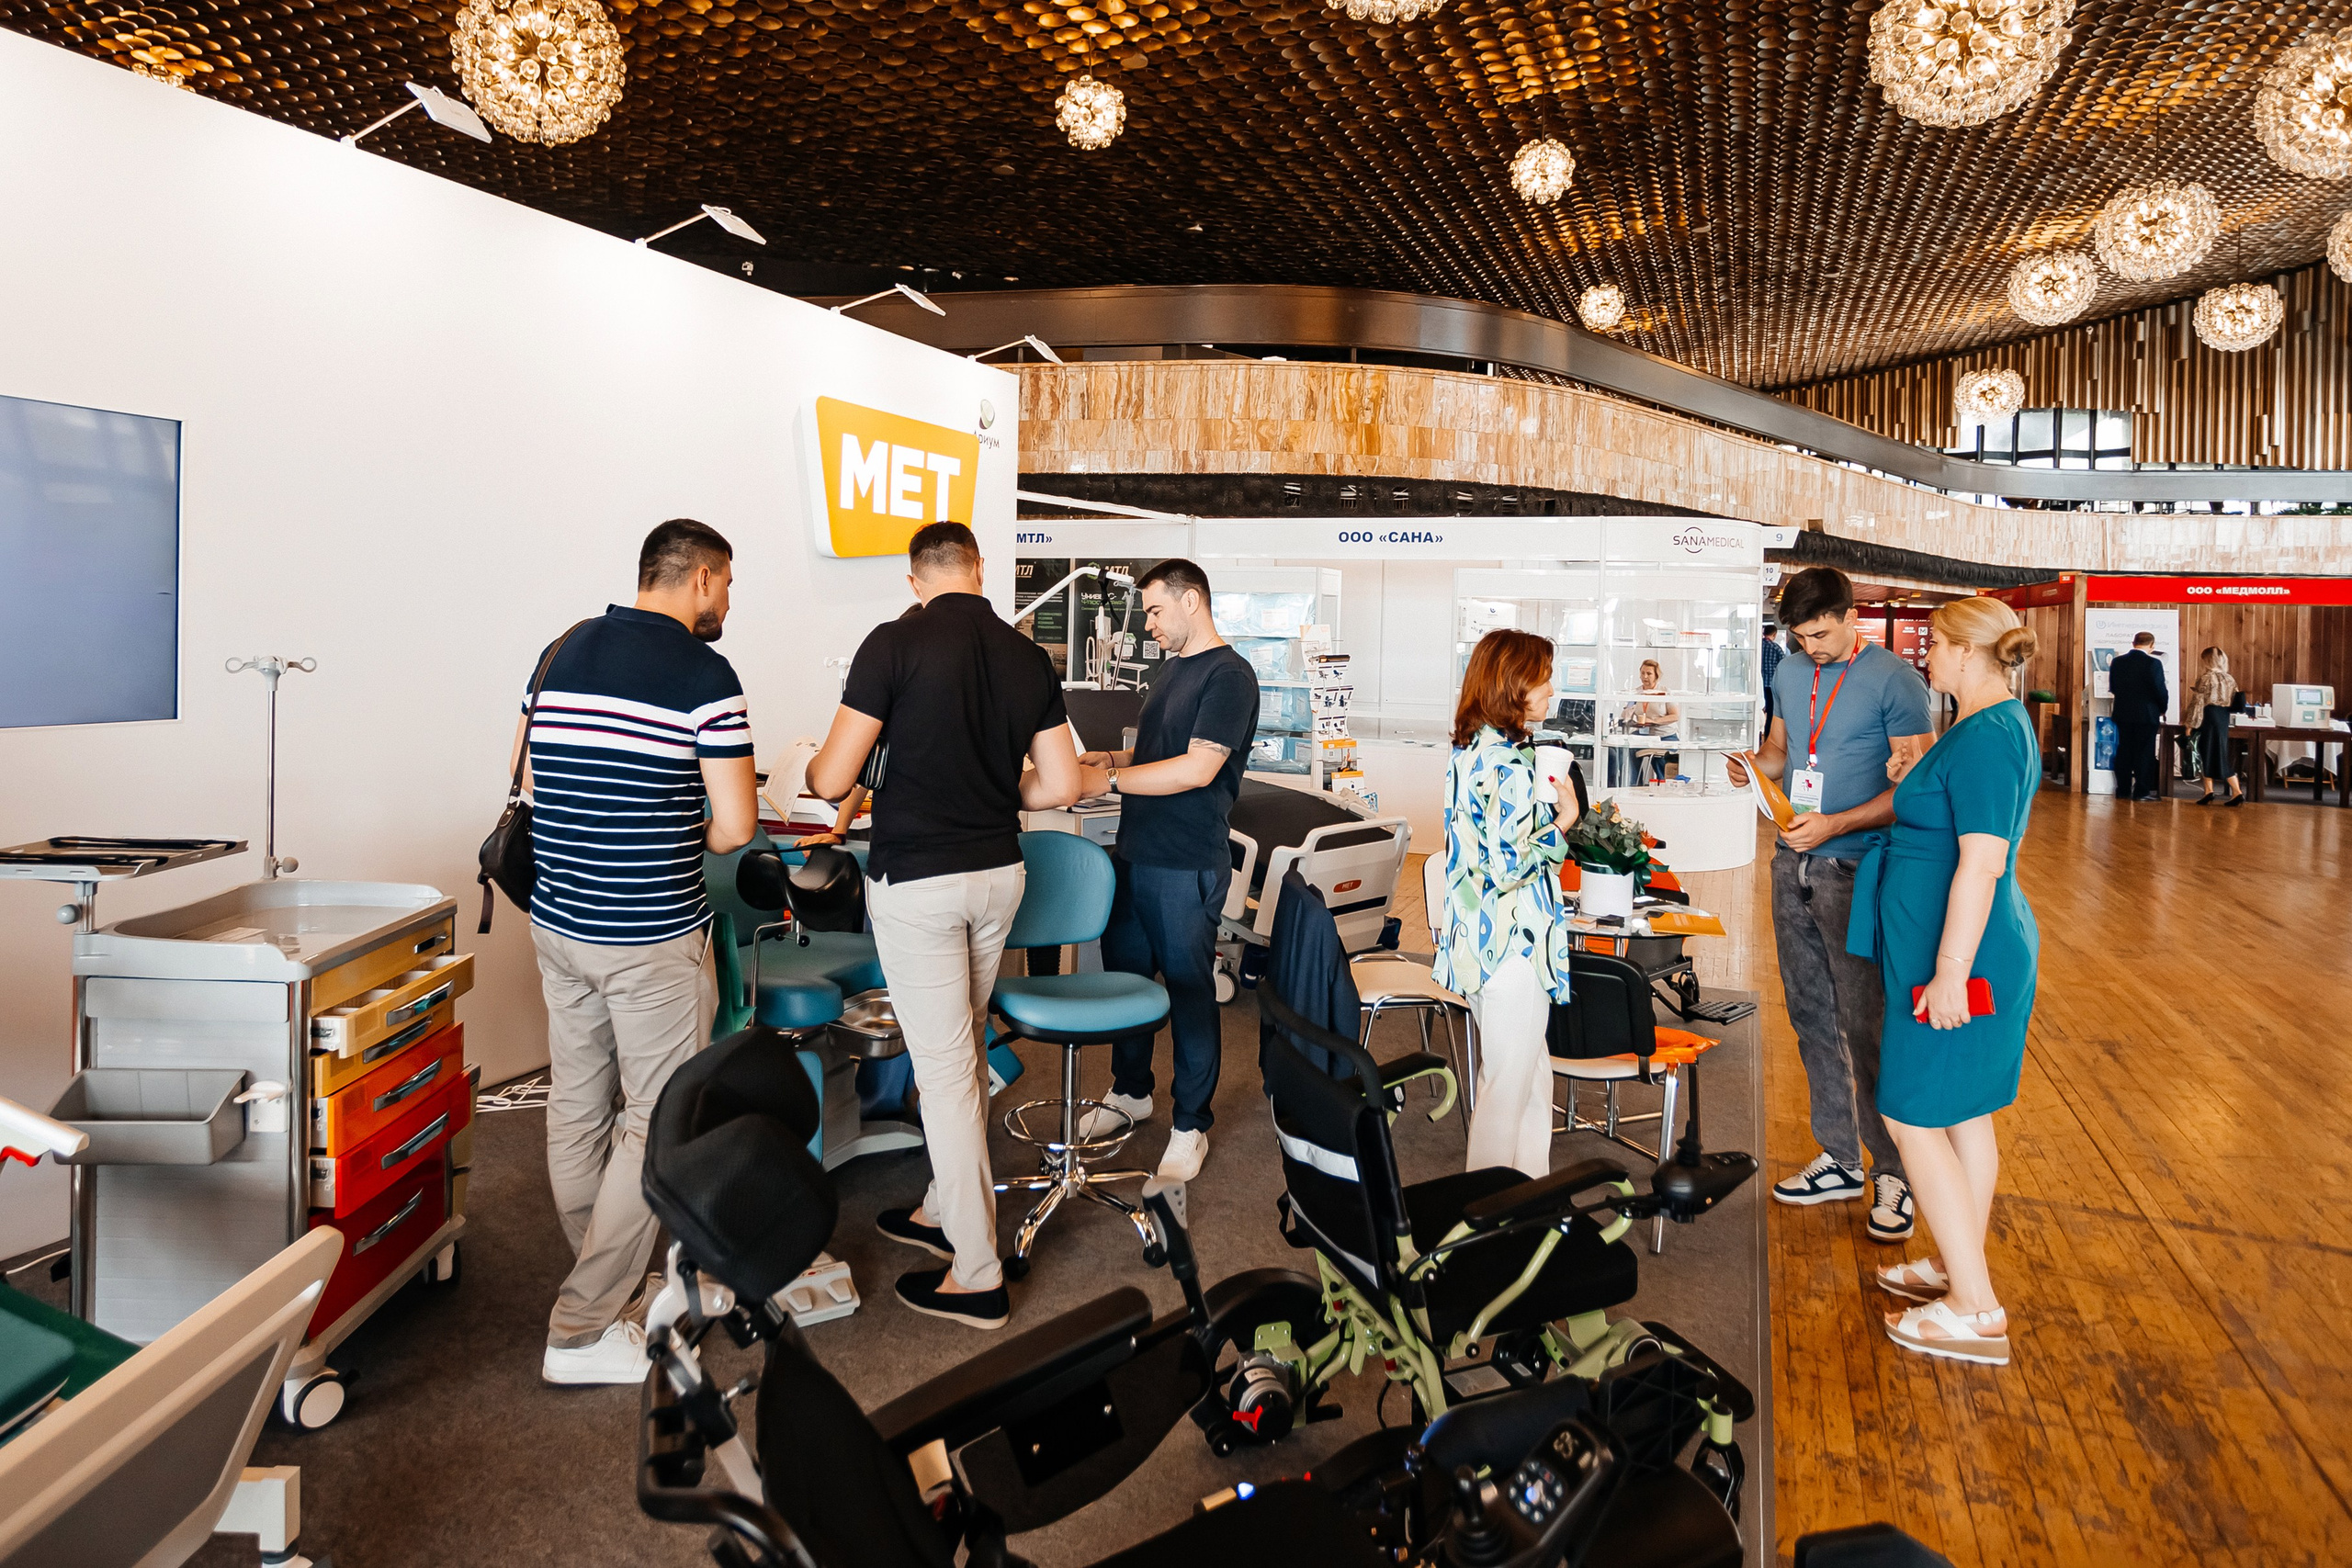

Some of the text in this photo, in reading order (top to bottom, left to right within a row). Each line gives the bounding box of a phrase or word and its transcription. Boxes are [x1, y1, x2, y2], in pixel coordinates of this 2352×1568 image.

[974, 430, 1000, 449] риум
[840, 433, 961, 523] МЕТ
[1338, 531, 1443, 543] ООО «САНА»
[1775, 533, 1783, 542] 9
[2187, 586, 2290, 596] ООО «МЕДМОЛЛ»
